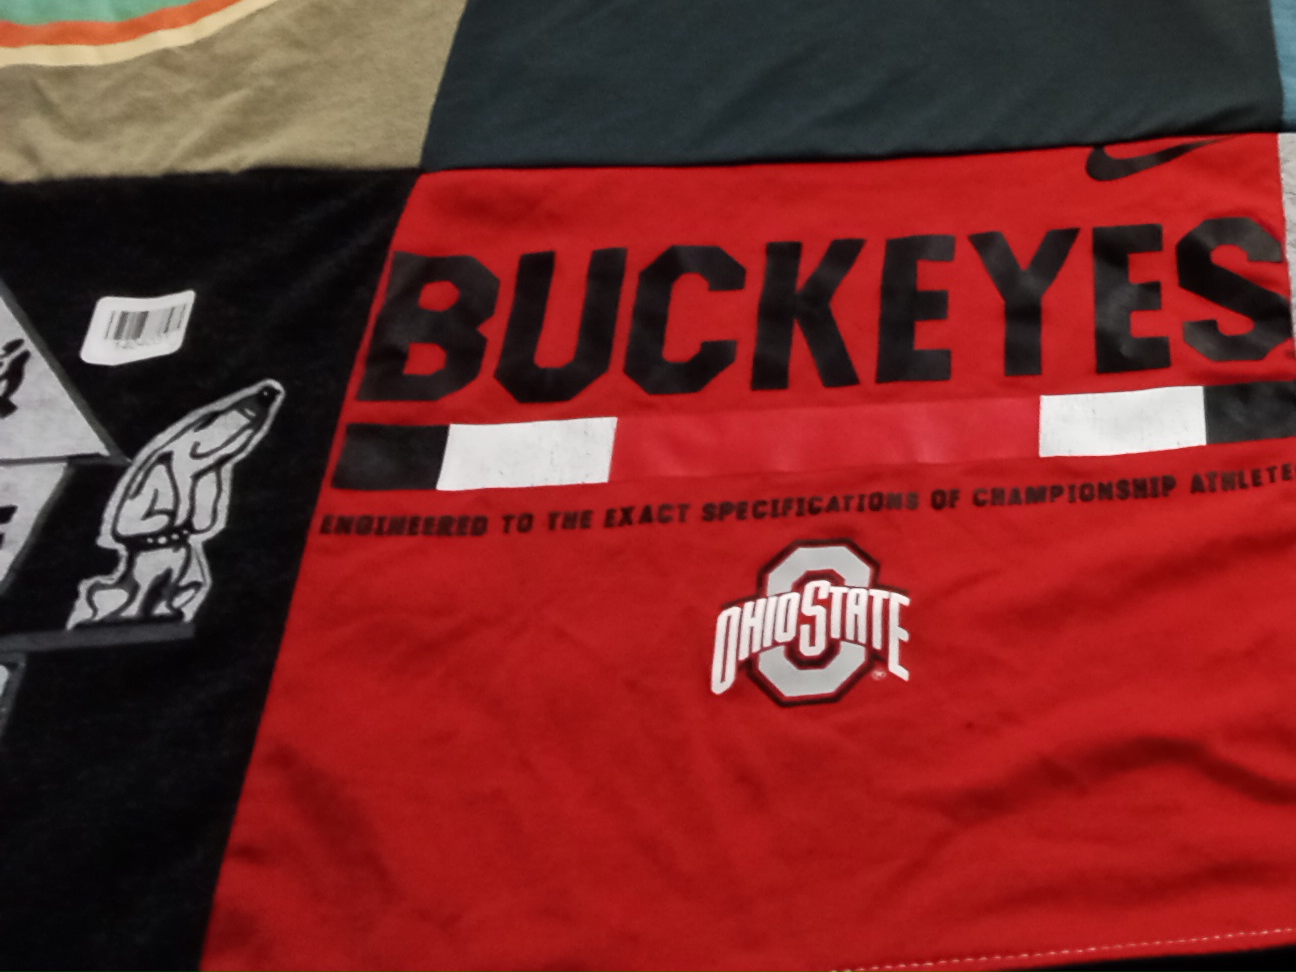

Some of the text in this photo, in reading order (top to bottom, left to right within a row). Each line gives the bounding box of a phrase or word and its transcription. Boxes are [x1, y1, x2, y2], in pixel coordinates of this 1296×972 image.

[354, 215, 1296, 404] BUCKEYES
[318, 514, 489, 537] ENGINEERED
[502, 513, 534, 534] TO
[547, 509, 593, 531] THE
[603, 502, 692, 529] EXACT
[701, 490, 920, 523] SPECIFICATIONS
[929, 488, 961, 511] OF
[971, 474, 1177, 507] CHAMPIONSHIP
